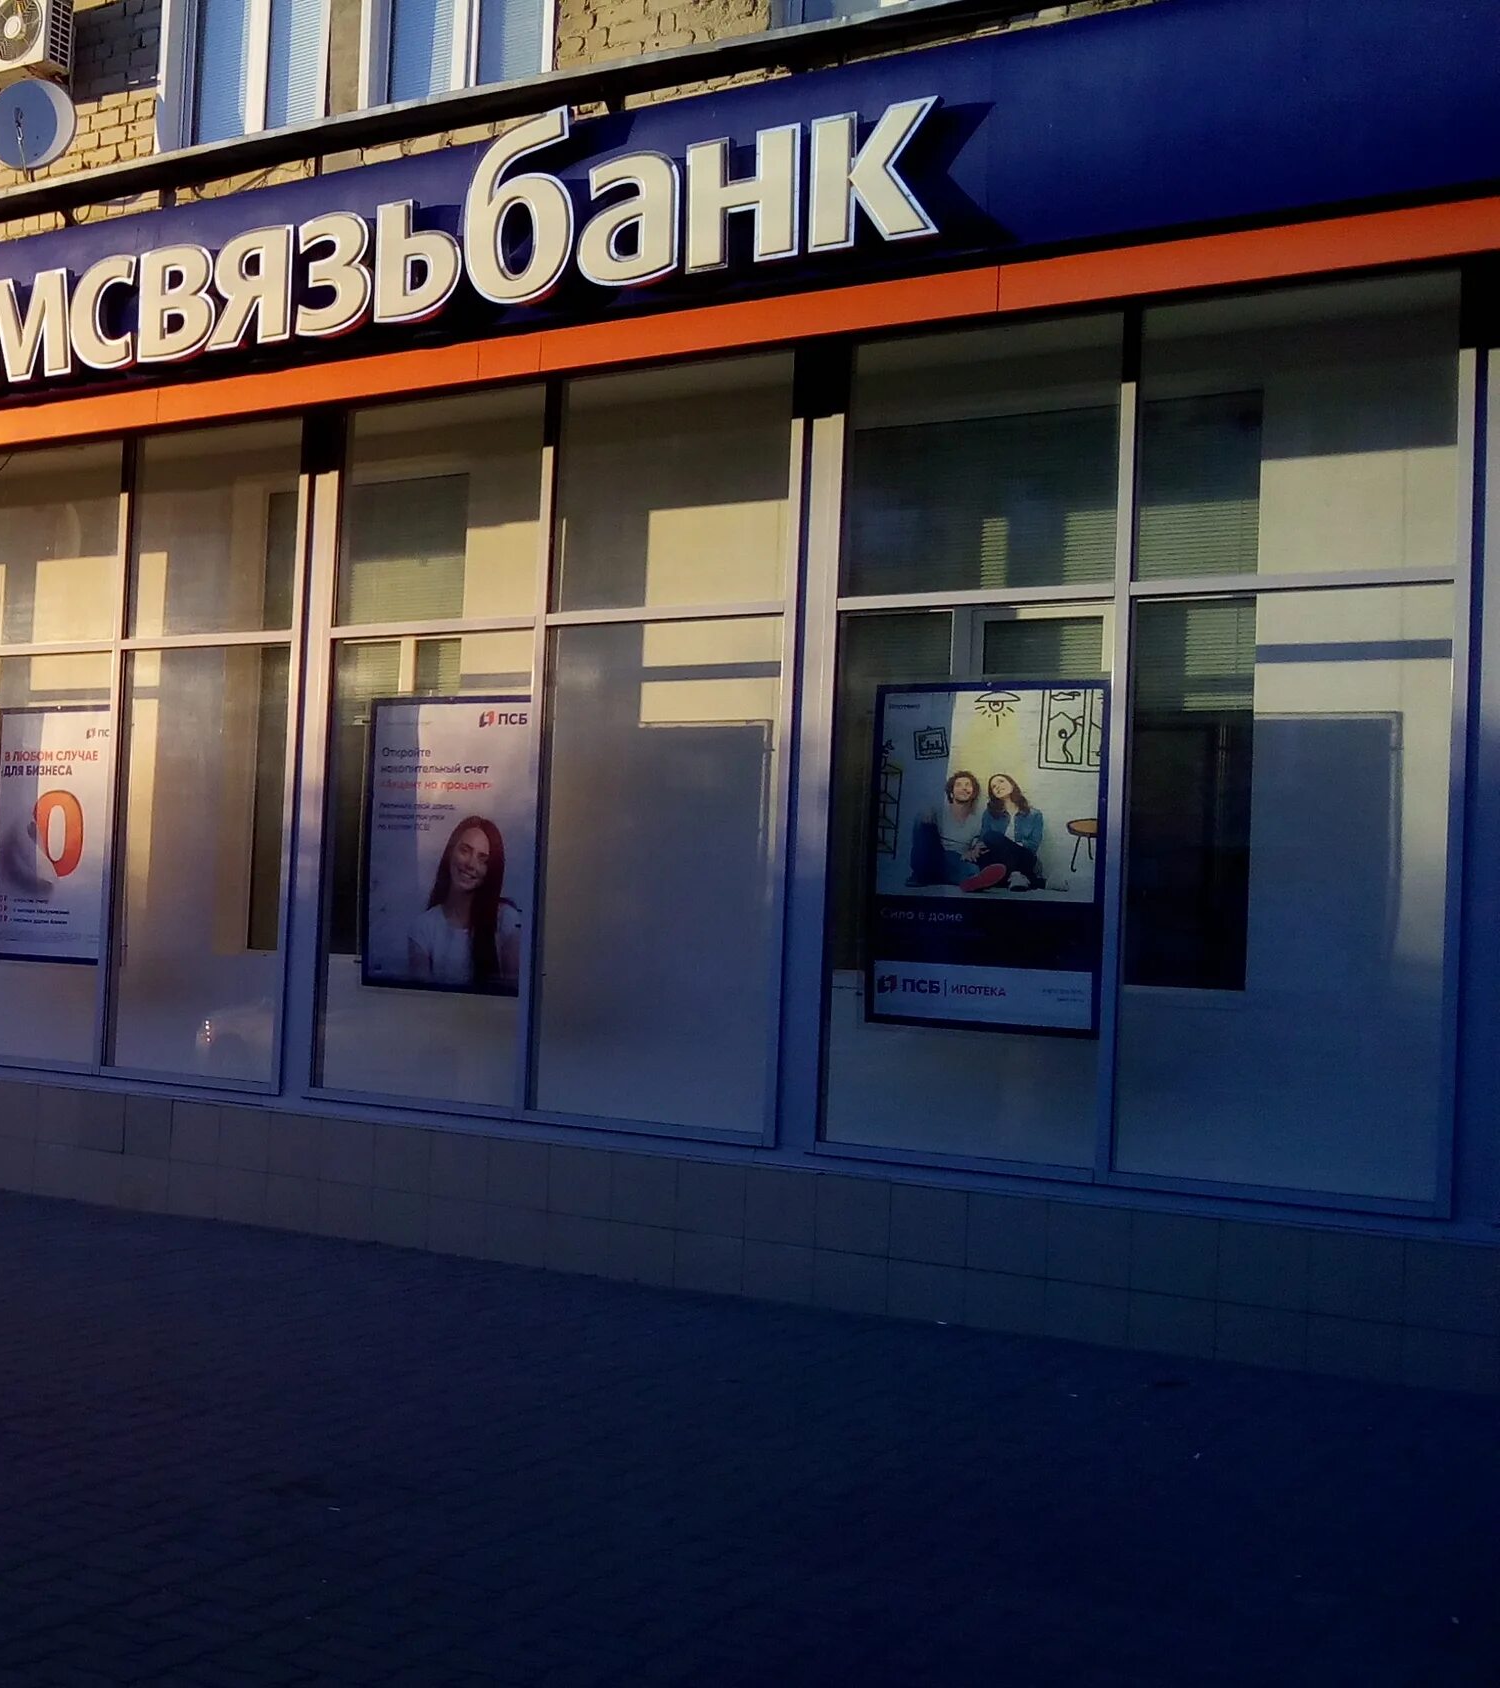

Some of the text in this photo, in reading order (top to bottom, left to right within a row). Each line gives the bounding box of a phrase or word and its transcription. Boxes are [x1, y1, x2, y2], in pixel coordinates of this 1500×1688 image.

[498, 713, 528, 726] ПСБ
[13, 751, 53, 762] ЛЮБОМ
[55, 751, 99, 762] СЛУЧАЕ
[382, 747, 431, 759] Откройте
[3, 765, 73, 777] ДЛЯ БИЗНЕСА
[380, 763, 489, 775] накопительный счет
[901, 978, 1007, 997] ПСБ ИПОТЕКА
